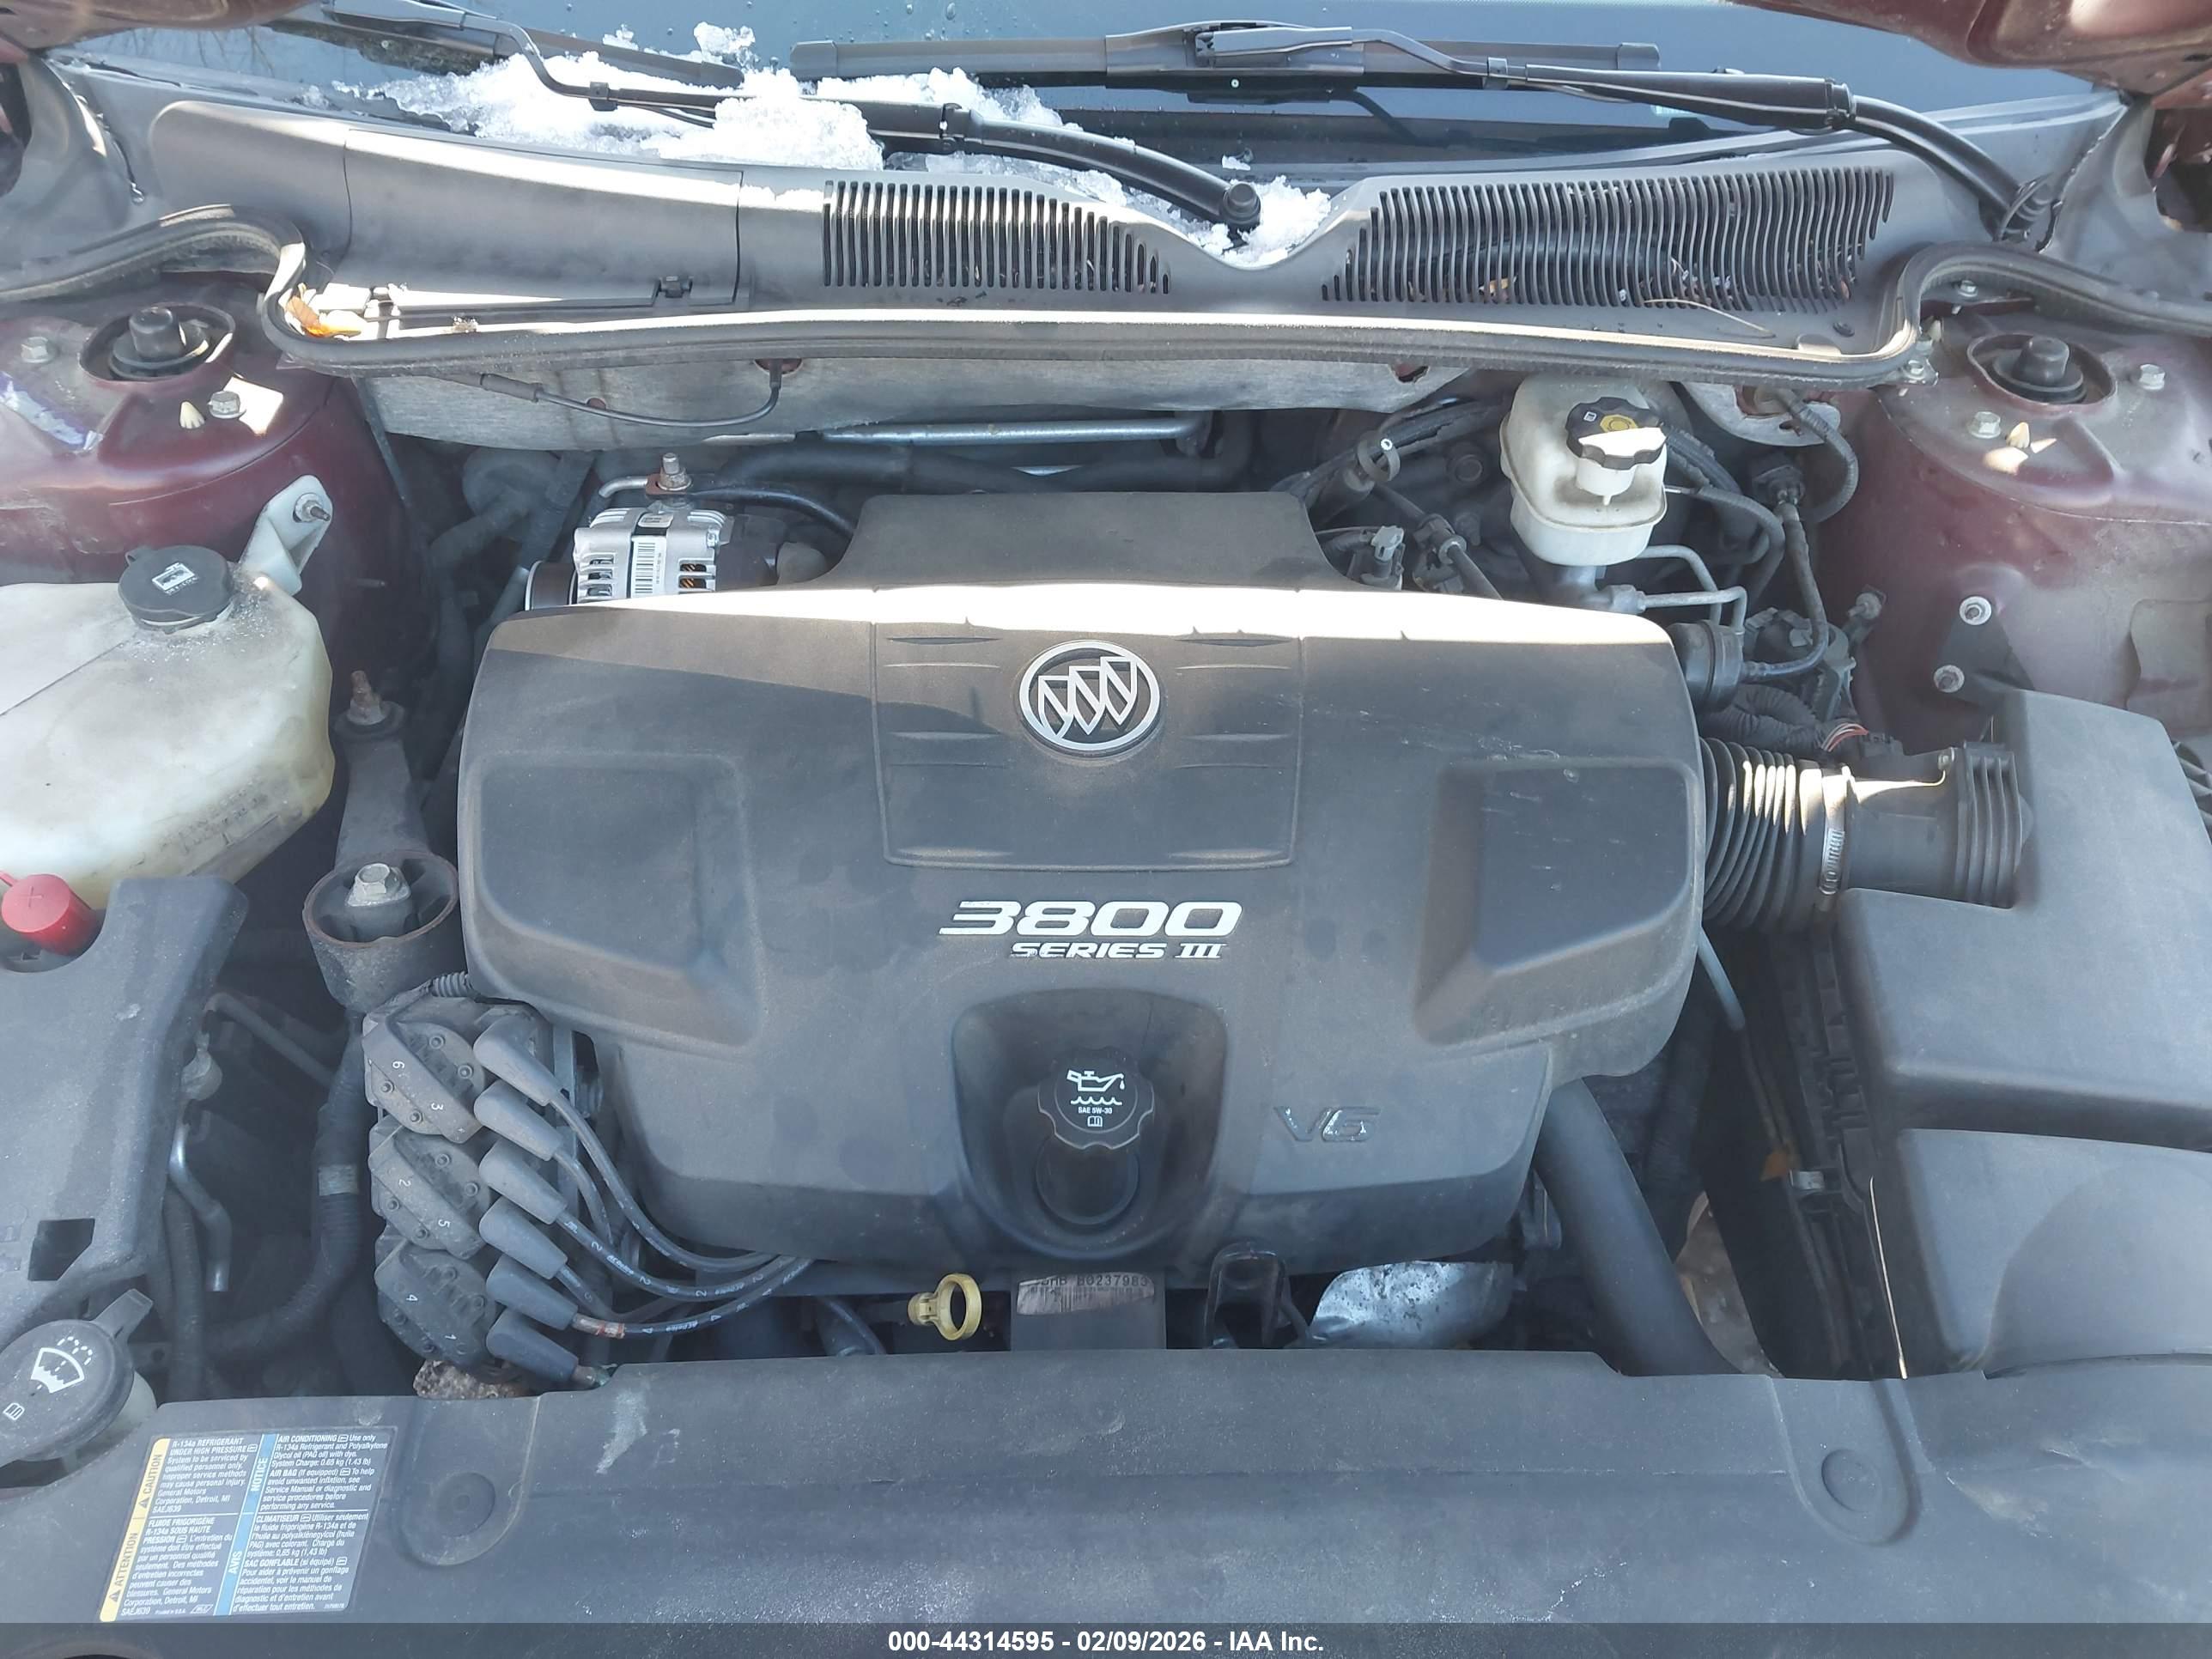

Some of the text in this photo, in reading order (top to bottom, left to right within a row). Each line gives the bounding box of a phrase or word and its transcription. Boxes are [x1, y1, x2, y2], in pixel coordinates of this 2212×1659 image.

[939, 901, 1243, 937] 3800
[1010, 942, 1227, 959] SERIES III
[1273, 1106, 1380, 1142] V6
[143, 1454, 163, 1495] CAUTION
[251, 1457, 268, 1492] NOTICE
[114, 1532, 138, 1587] ATTENTION
[228, 1551, 243, 1575] AVIS
